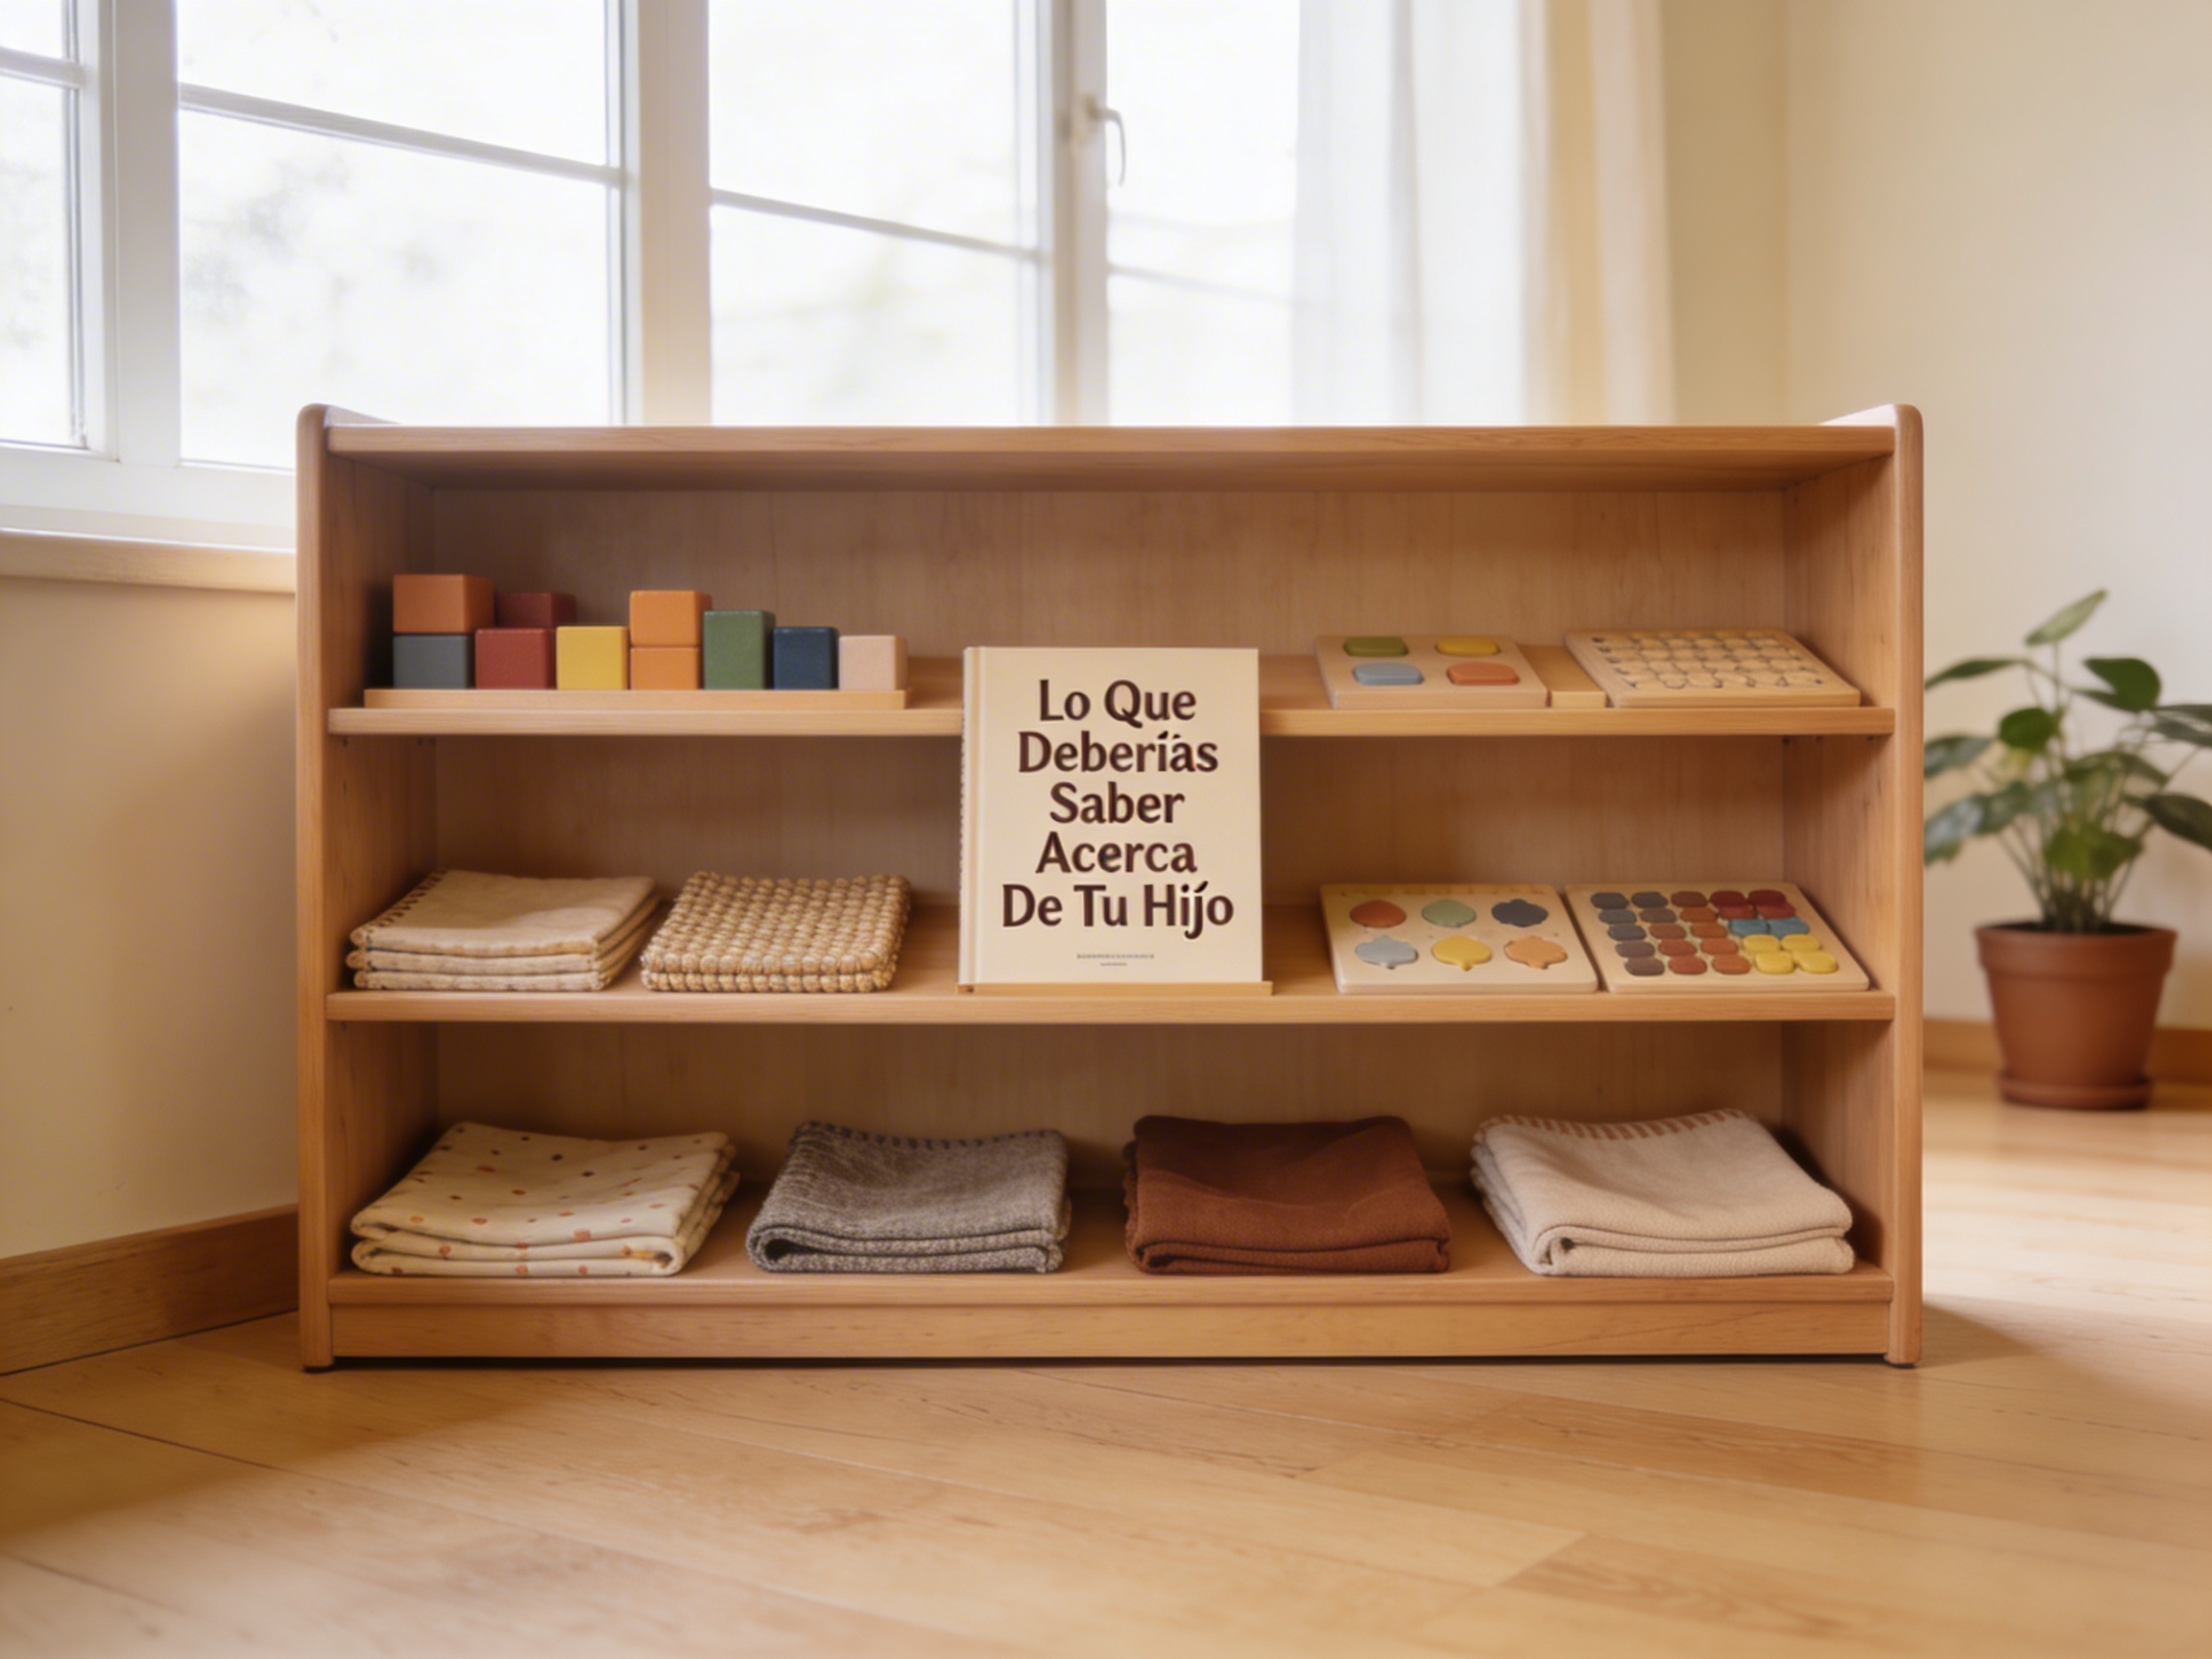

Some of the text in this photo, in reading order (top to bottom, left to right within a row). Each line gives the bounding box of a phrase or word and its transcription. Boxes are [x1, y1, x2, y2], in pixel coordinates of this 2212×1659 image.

[1039, 679, 1197, 730] Lo Que
[1049, 781, 1186, 824] Saber
[1035, 830, 1198, 874] Acerca
[1002, 883, 1063, 927] De
[1072, 884, 1128, 927] Tu
